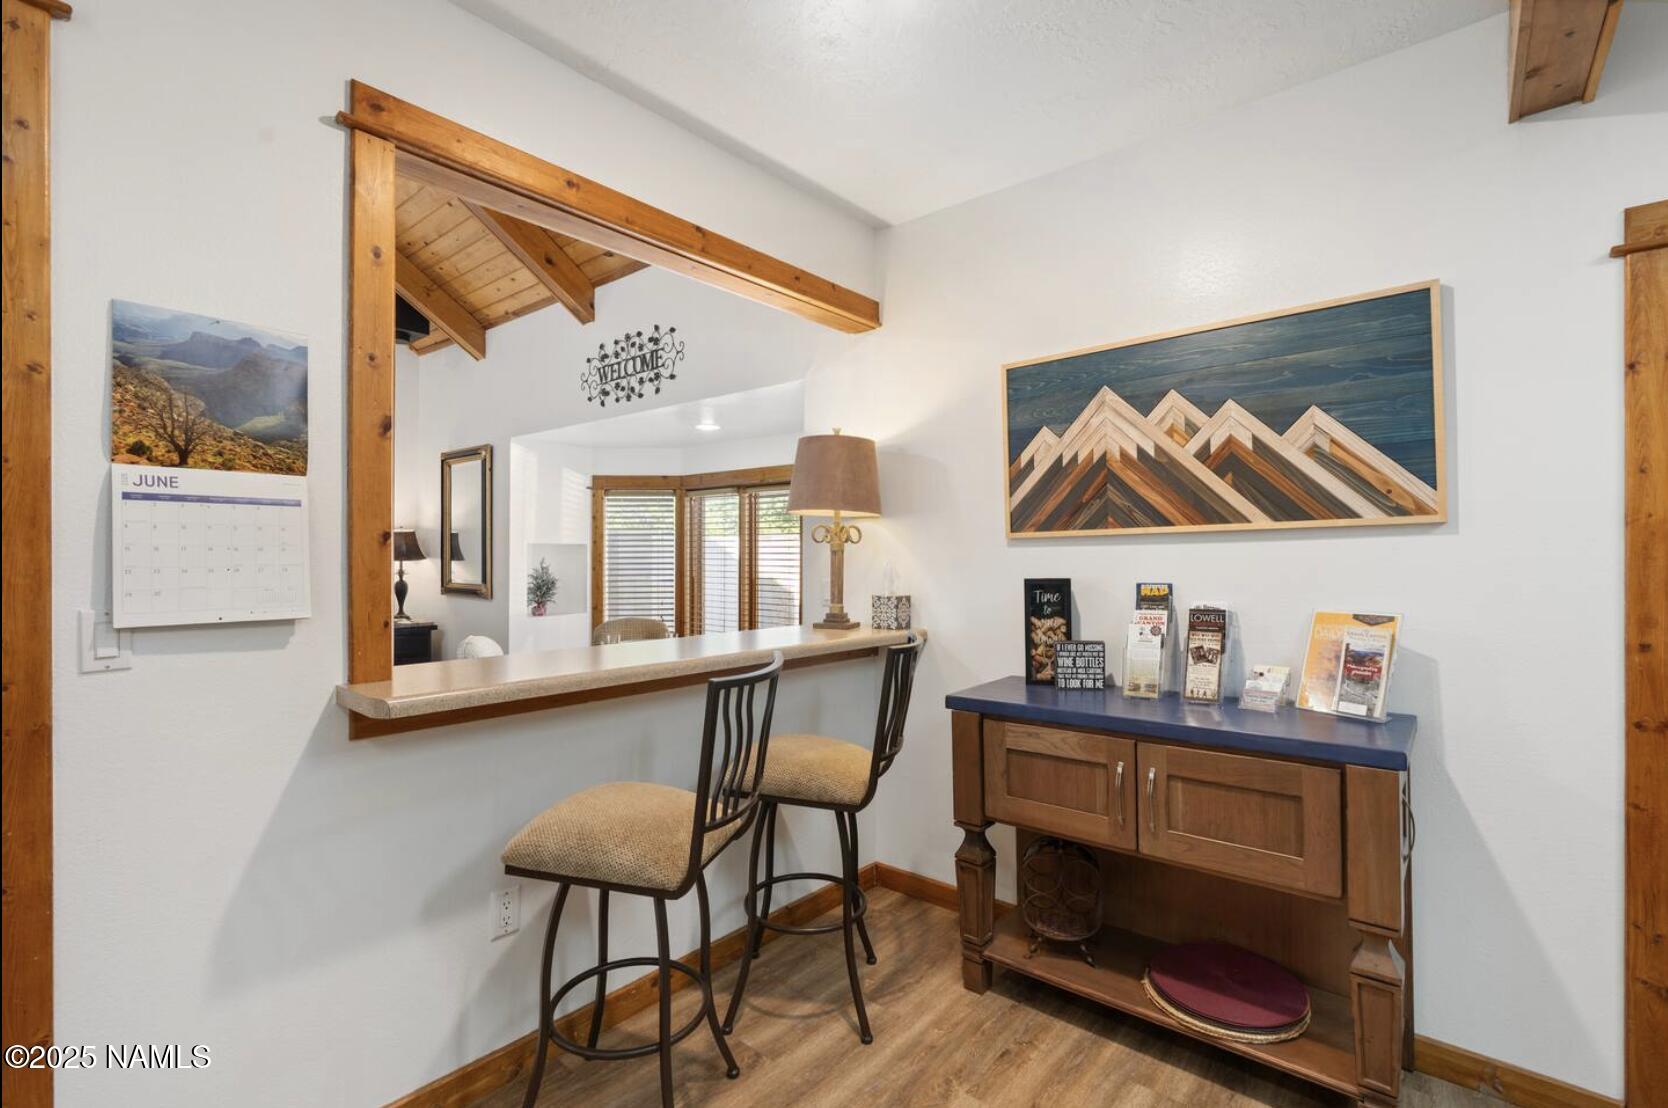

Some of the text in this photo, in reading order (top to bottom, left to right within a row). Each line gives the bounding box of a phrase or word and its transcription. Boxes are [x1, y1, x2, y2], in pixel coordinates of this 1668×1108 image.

[598, 348, 664, 386] WELCOME
[132, 474, 179, 489] JUNE
[1033, 589, 1062, 604] Time
[1190, 613, 1225, 623] LOWELL
[1057, 657, 1104, 668] WINE BOTTLES
[1057, 678, 1104, 689] TO LOOK FOR ME
